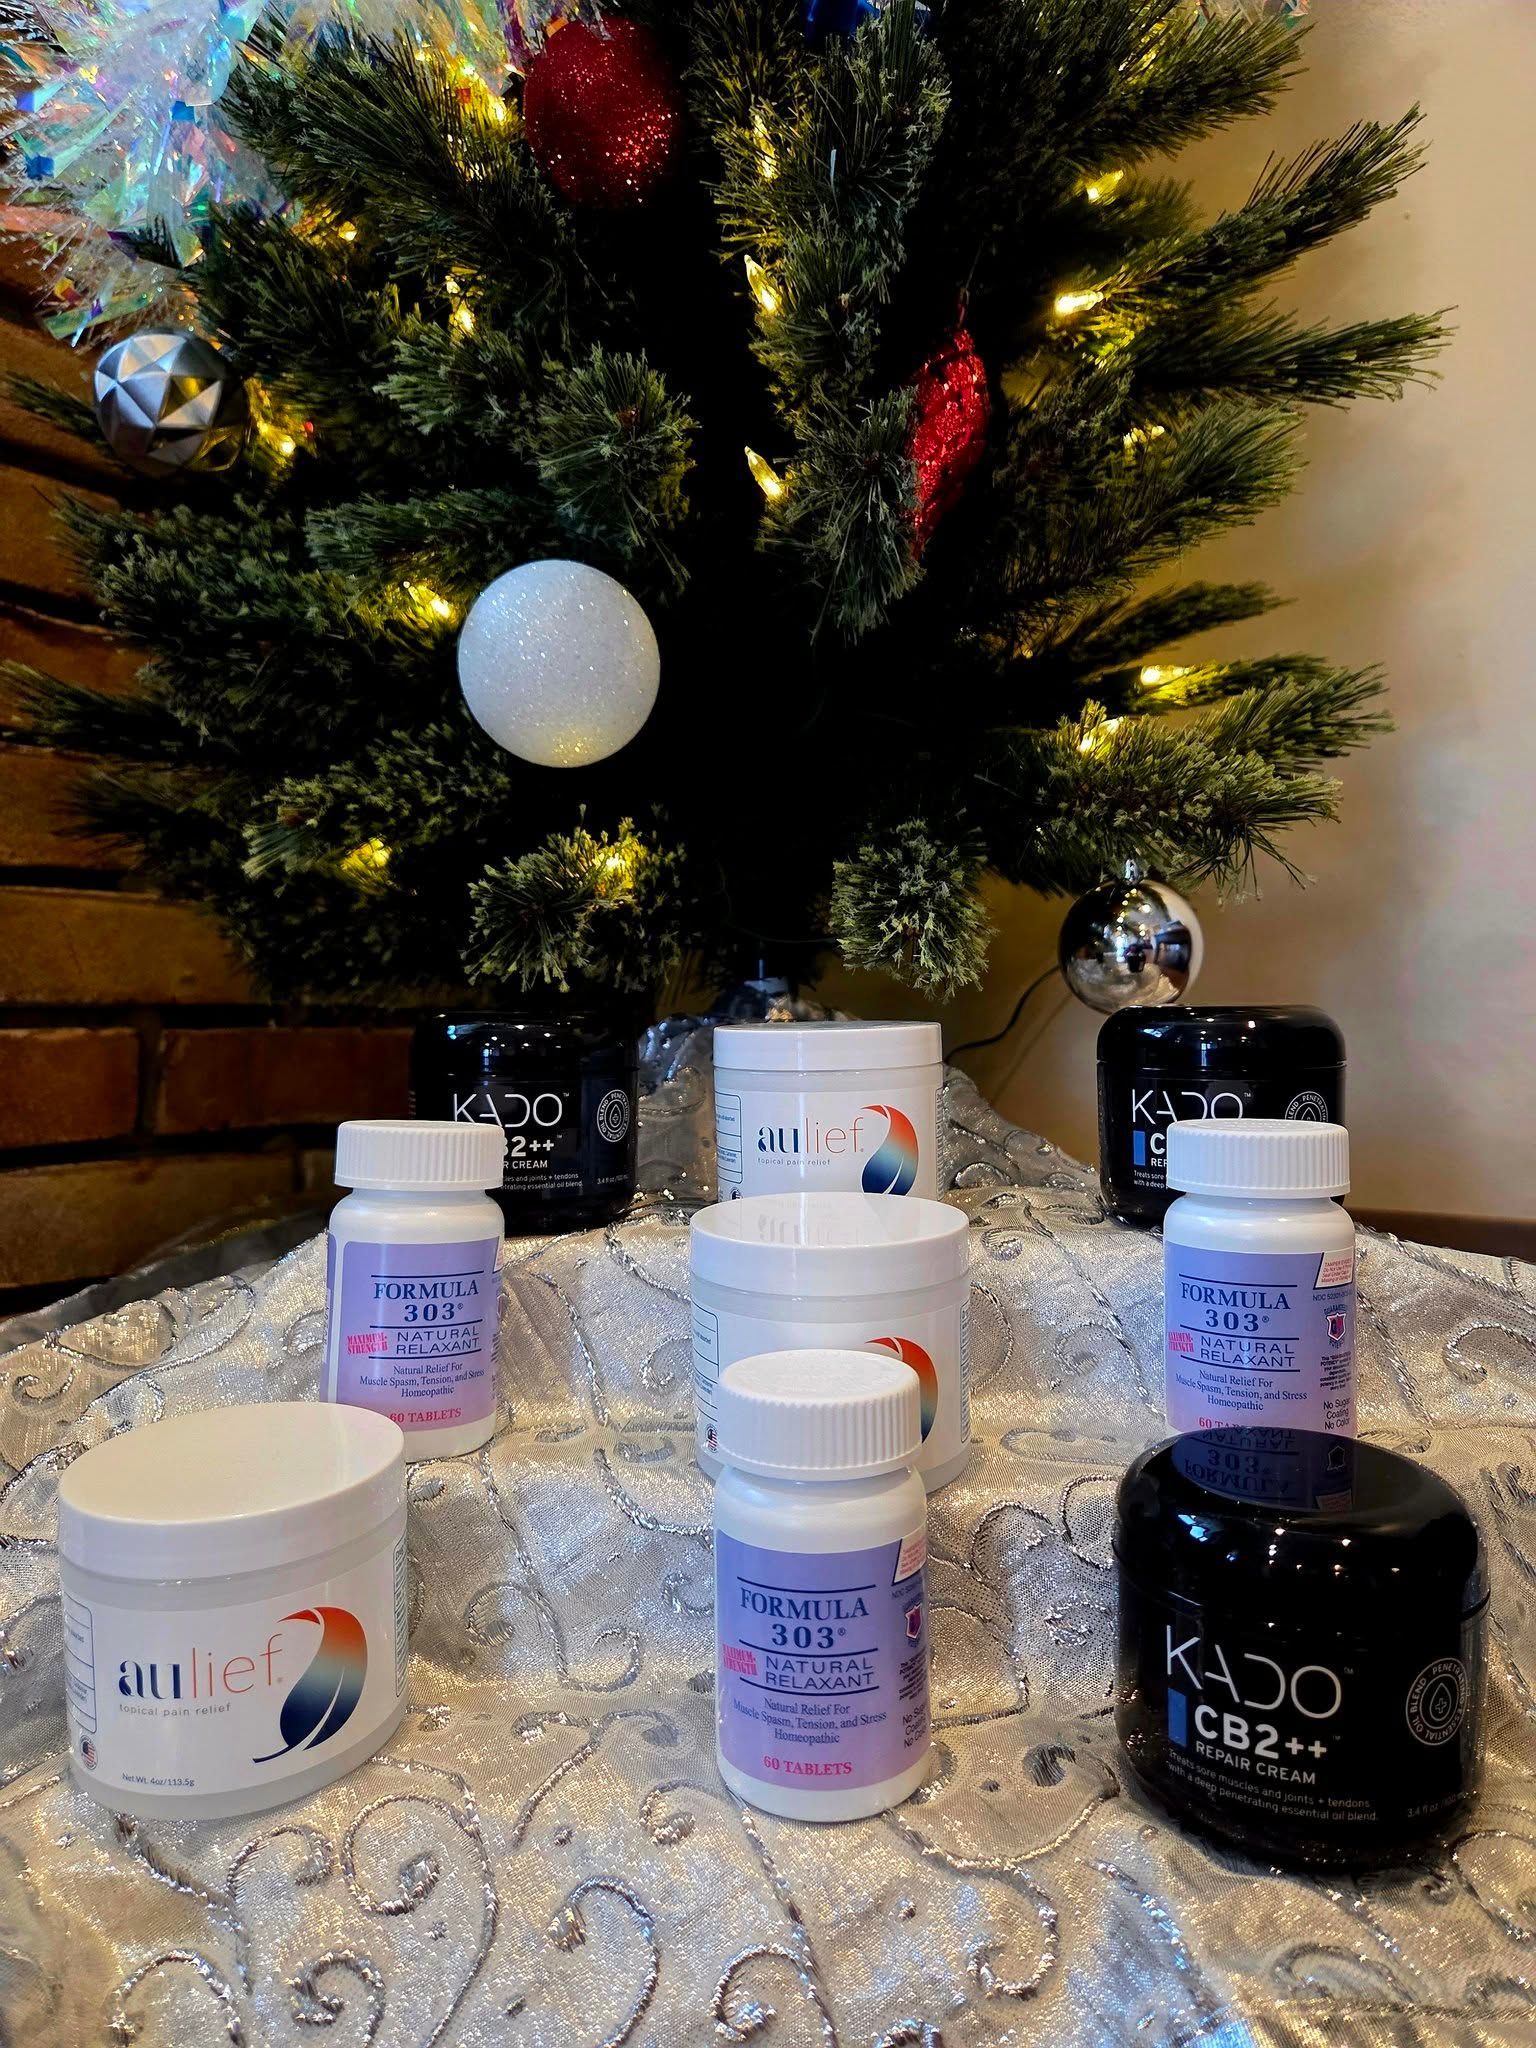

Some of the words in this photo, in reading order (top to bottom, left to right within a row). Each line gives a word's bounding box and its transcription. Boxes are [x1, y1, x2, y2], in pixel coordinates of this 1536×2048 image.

[758, 1117, 864, 1154] aulief
[512, 1160, 548, 1169] CREAM
[758, 1158, 784, 1166] topical
[786, 1158, 804, 1166] pain
[808, 1158, 831, 1166] relief
[554, 1172, 578, 1180] tendons
[1150, 1181, 1164, 1189] deep
[528, 1181, 556, 1190] essential
[374, 1280, 479, 1300] FORMULA
[1181, 1282, 1291, 1310] FORMULA
[397, 1326, 480, 1342] NATURAL
[396, 1337, 480, 1355] RELAXANT
[1201, 1336, 1294, 1354] NATURAL
[1200, 1350, 1296, 1368] RELAXANT
[393, 1365, 424, 1376] Natural
[426, 1364, 448, 1374] Relief
[450, 1362, 463, 1372] For
[360, 1376, 388, 1386] Muscle
[390, 1376, 420, 1388] Spasm,
[420, 1374, 452, 1386] Tension,
[454, 1372, 468, 1382] and
[468, 1369, 484, 1380] Stress
[1175, 1373, 1197, 1389] Muscle
[1197, 1383, 1224, 1396] Spasm,
[1225, 1387, 1262, 1400] Tension,
[1264, 1390, 1280, 1400] and
[1282, 1390, 1308, 1400] Stress
[1200, 1370, 1228, 1384] Natural
[1230, 1375, 1256, 1387] Relief
[1258, 1376, 1273, 1388] For
[401, 1386, 454, 1398] Homeopathic
[1206, 1394, 1264, 1411] Homeopathic
[1324, 1400, 1334, 1410] No
[390, 1412, 404, 1422] 60
[408, 1407, 462, 1422] TABLETS
[1199, 1417, 1212, 1428] 60
[1326, 1408, 1349, 1420] Coating
[1324, 1420, 1334, 1430] No
[740, 1587, 869, 1622] FORMULA
[119, 1633, 282, 1700] aulief
[766, 1656, 873, 1674] NATURAL
[765, 1672, 875, 1690] RELAXANT
[1410, 1677, 1428, 1713] BLEND
[120, 1704, 158, 1717] topical
[163, 1708, 190, 1717] pain
[196, 1702, 231, 1715] relief
[734, 1699, 760, 1720] Muscle
[762, 1710, 794, 1728] Spasm,
[796, 1716, 838, 1730] Tension,
[840, 1714, 858, 1728] and
[860, 1711, 887, 1726] Stress
[764, 1698, 798, 1714] Natural
[801, 1703, 831, 1716] Relief
[834, 1704, 851, 1715] For
[902, 1714, 913, 1726] No
[1412, 1716, 1423, 1733] OIL
[774, 1728, 840, 1746] Homeopathic
[904, 1737, 914, 1750] No
[764, 1756, 780, 1770] 60
[784, 1761, 852, 1776] TABLETS
[1196, 1740, 1250, 1772] REPAIR
[1256, 1762, 1316, 1785] CREAM
[122, 1772, 134, 1782] Net
[150, 1778, 195, 1787] 4oz/113.5g
[1196, 1776, 1217, 1793] deep
[1219, 1786, 1278, 1814] penetrating
[1282, 1804, 1330, 1820] essential
[1332, 1808, 1344, 1820] oil
[1218, 1774, 1260, 1794] muscles
[1262, 1788, 1282, 1800] and
[1284, 1791, 1314, 1806] joints
[1328, 1798, 1370, 1808] tendons
